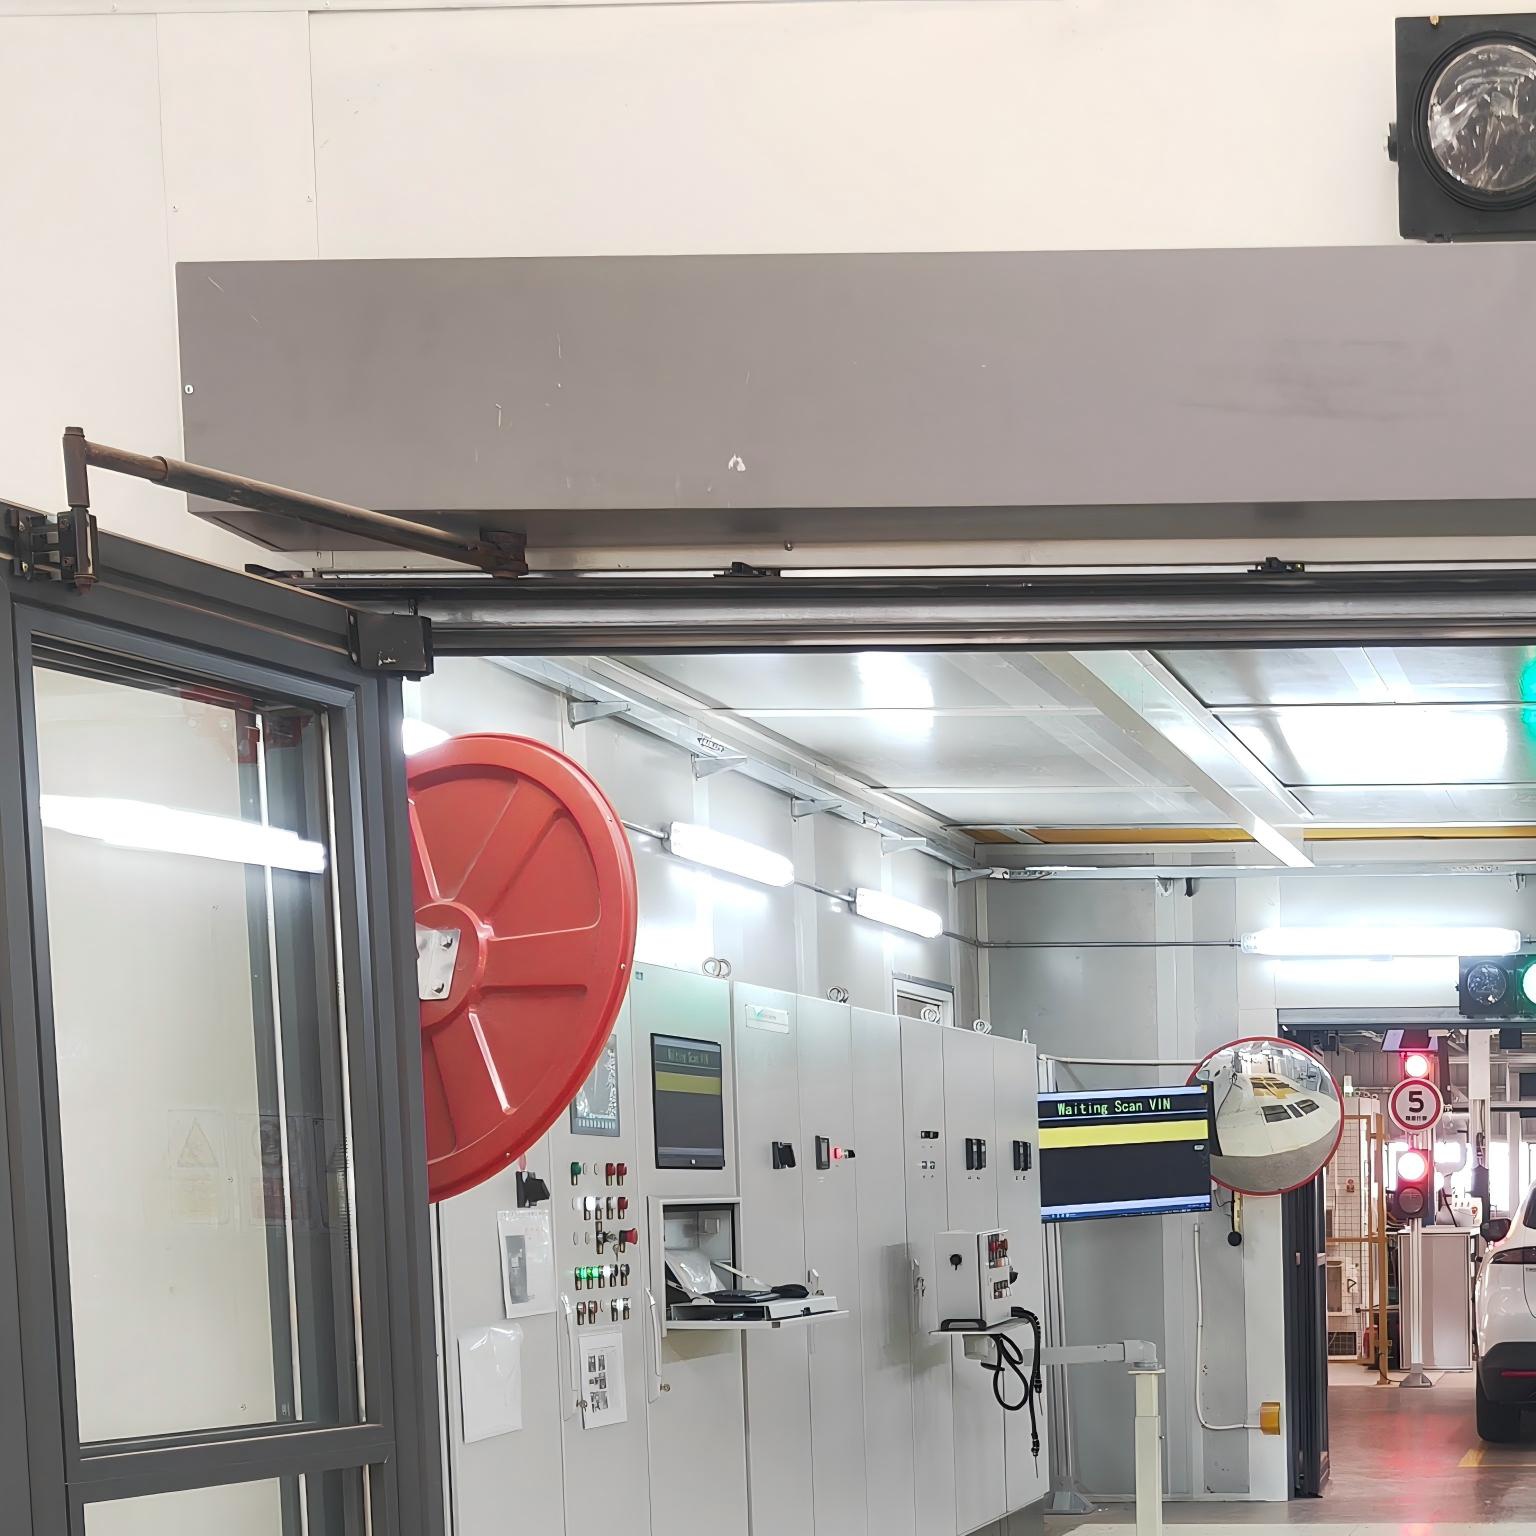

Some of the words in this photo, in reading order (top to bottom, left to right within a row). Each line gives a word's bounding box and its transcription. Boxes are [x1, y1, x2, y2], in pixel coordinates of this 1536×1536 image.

[1057, 1103, 1108, 1115] Waiting
[1114, 1100, 1143, 1112] Scan
[1149, 1097, 1171, 1111] VIN
[1408, 1090, 1425, 1113] 5
